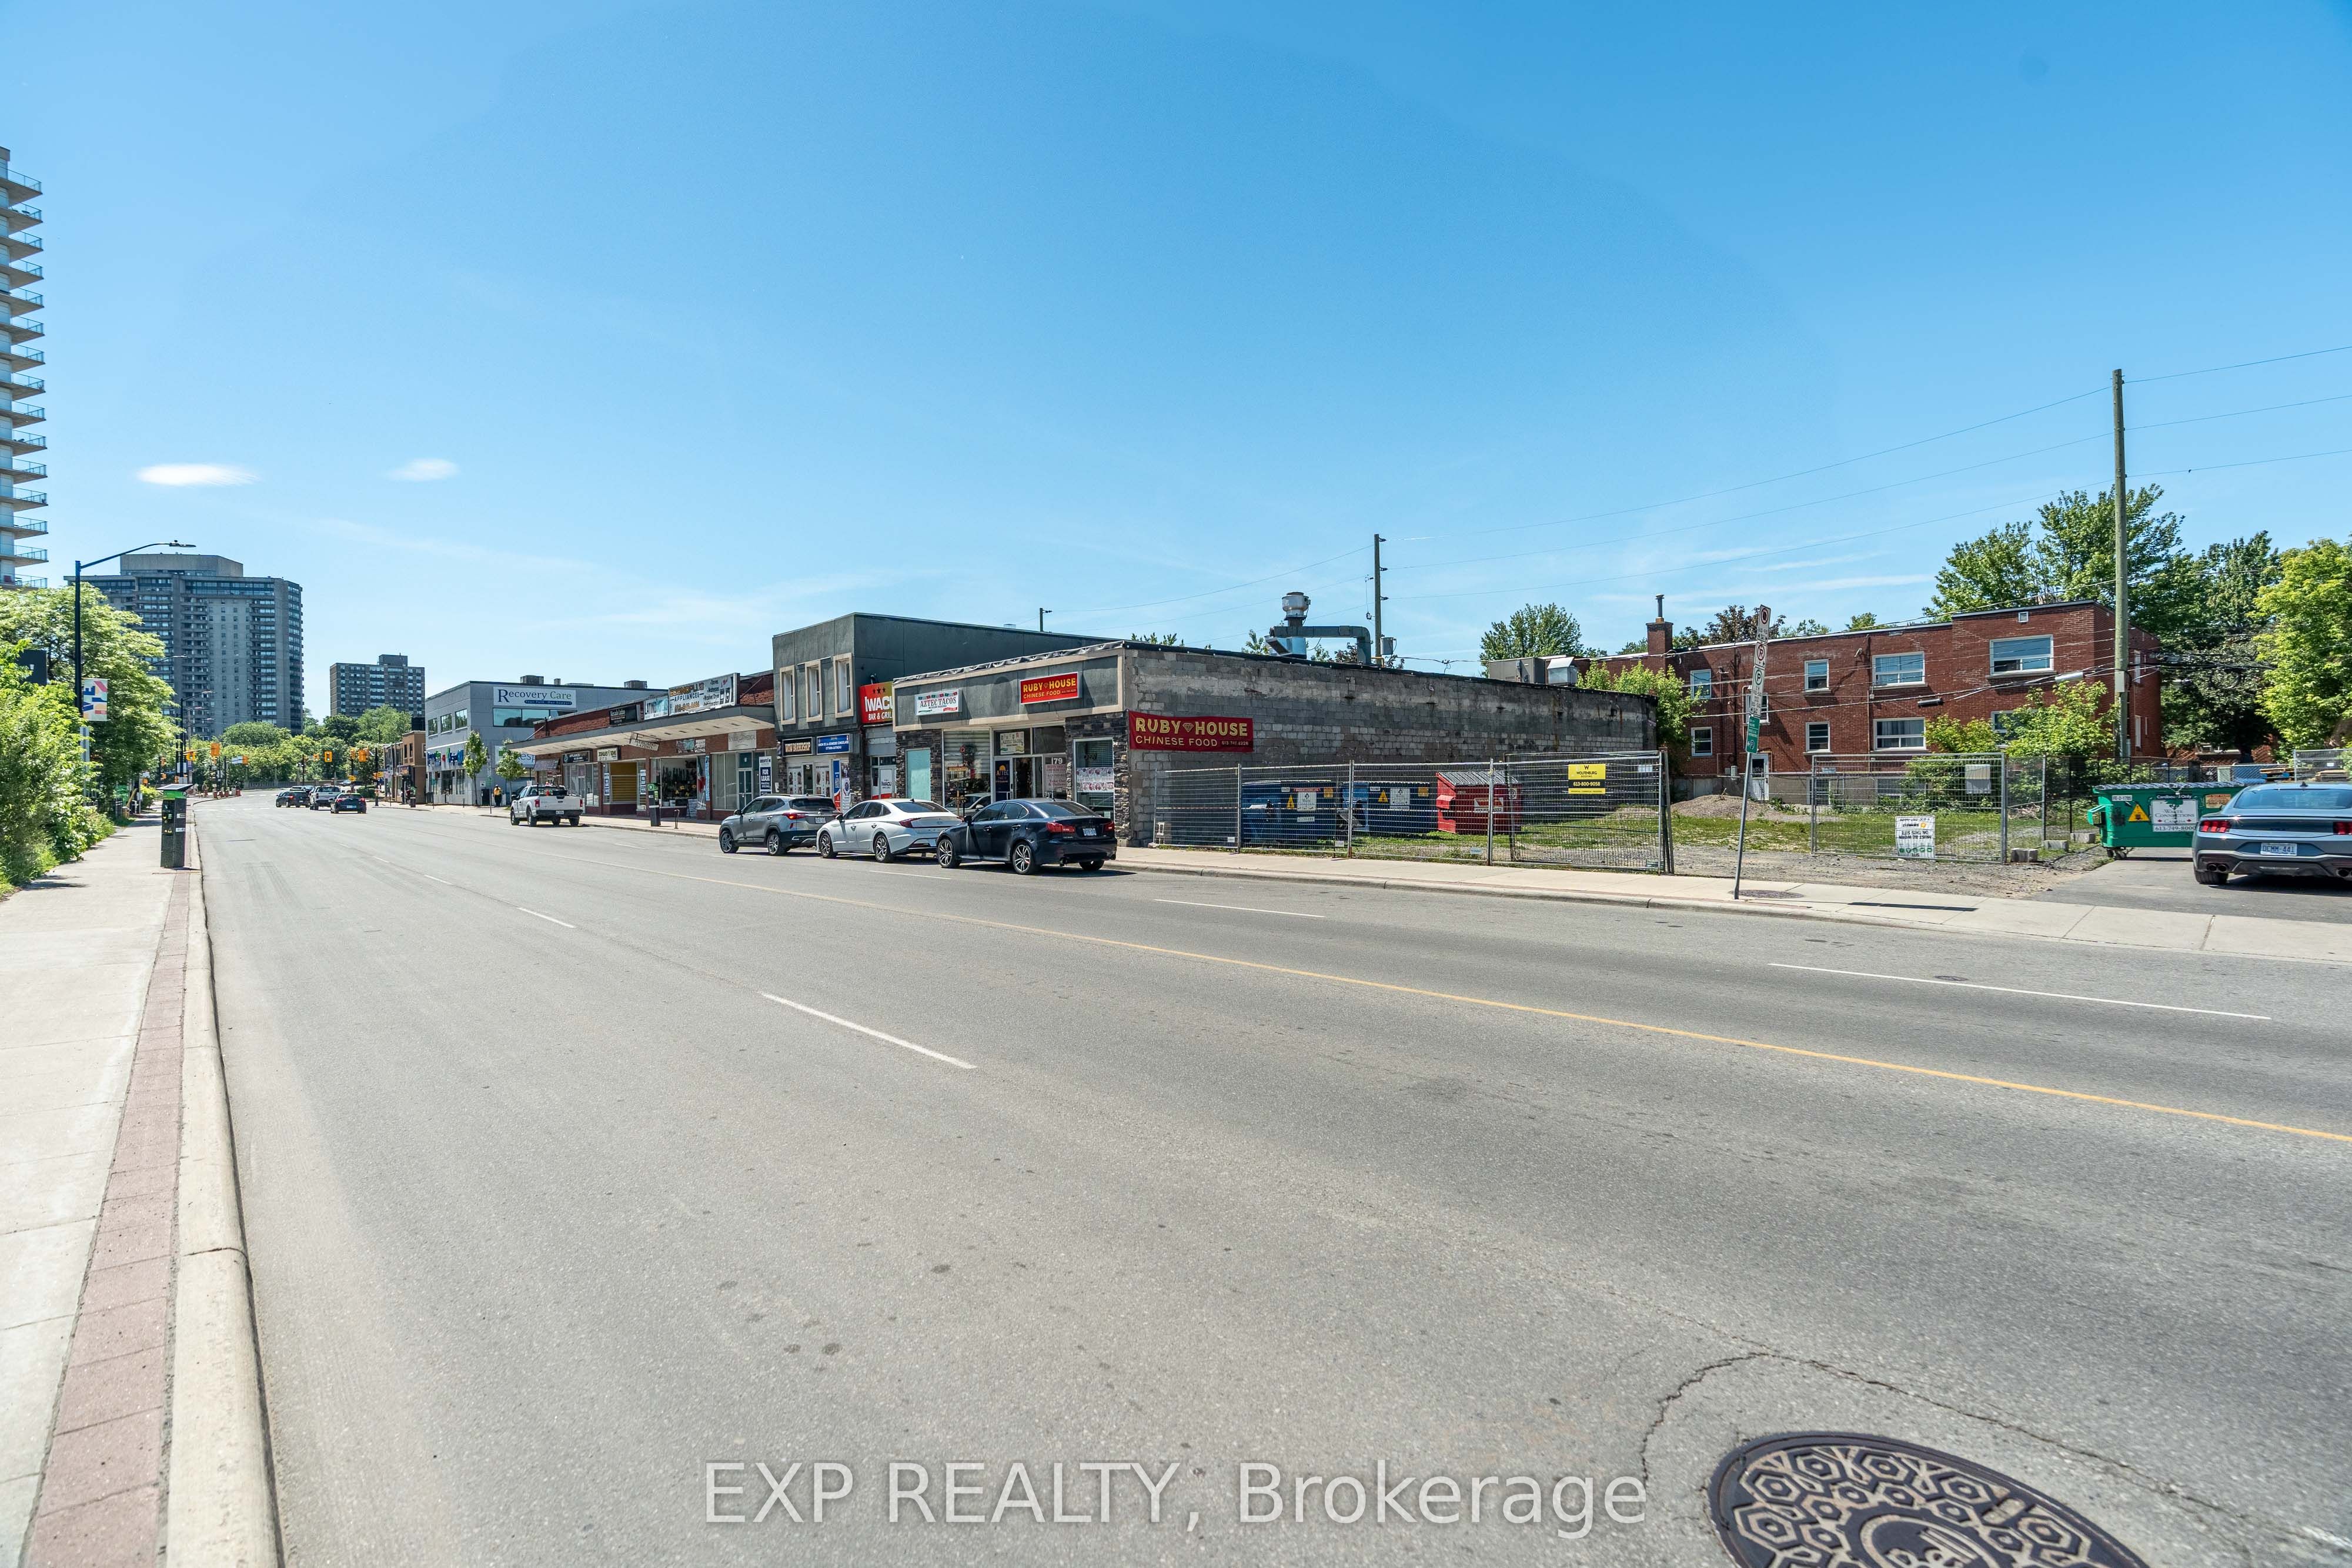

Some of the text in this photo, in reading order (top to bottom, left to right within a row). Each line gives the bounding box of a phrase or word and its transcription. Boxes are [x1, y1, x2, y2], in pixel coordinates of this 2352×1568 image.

[1023, 678, 1076, 693] RUBY HOUSE
[497, 689, 572, 703] Recovery Care
[674, 693, 700, 702] APPLIANCES
[938, 697, 956, 706] TACOS
[1136, 717, 1248, 737] RUBY HOUSE
[1135, 735, 1218, 747] CHINESE FOOD
[785, 742, 811, 753] WOW BARBERSHOP
